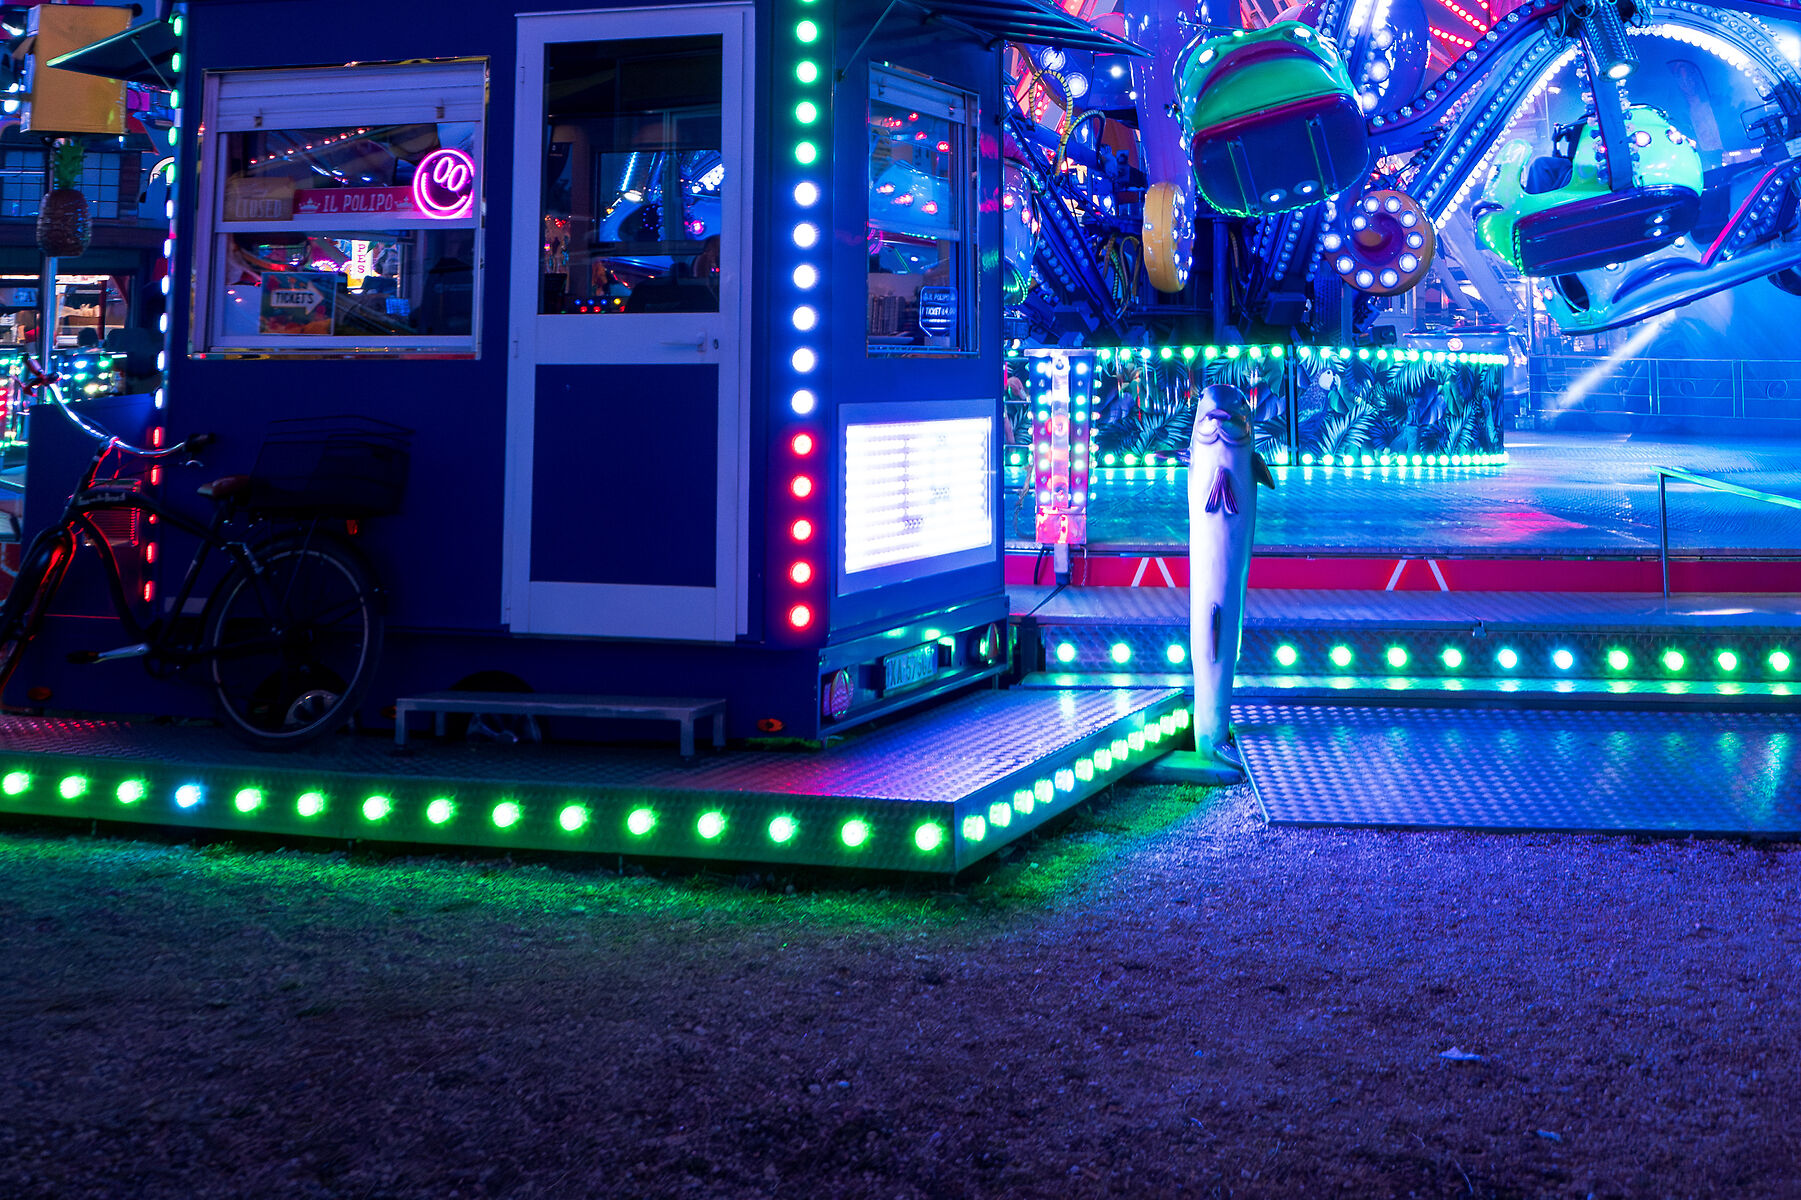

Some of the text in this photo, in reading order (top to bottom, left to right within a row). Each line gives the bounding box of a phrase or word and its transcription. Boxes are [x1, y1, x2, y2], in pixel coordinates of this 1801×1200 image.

[323, 193, 393, 212] IL POLIPO
[275, 292, 314, 305] TICKETS
[926, 306, 942, 316] TICKET
